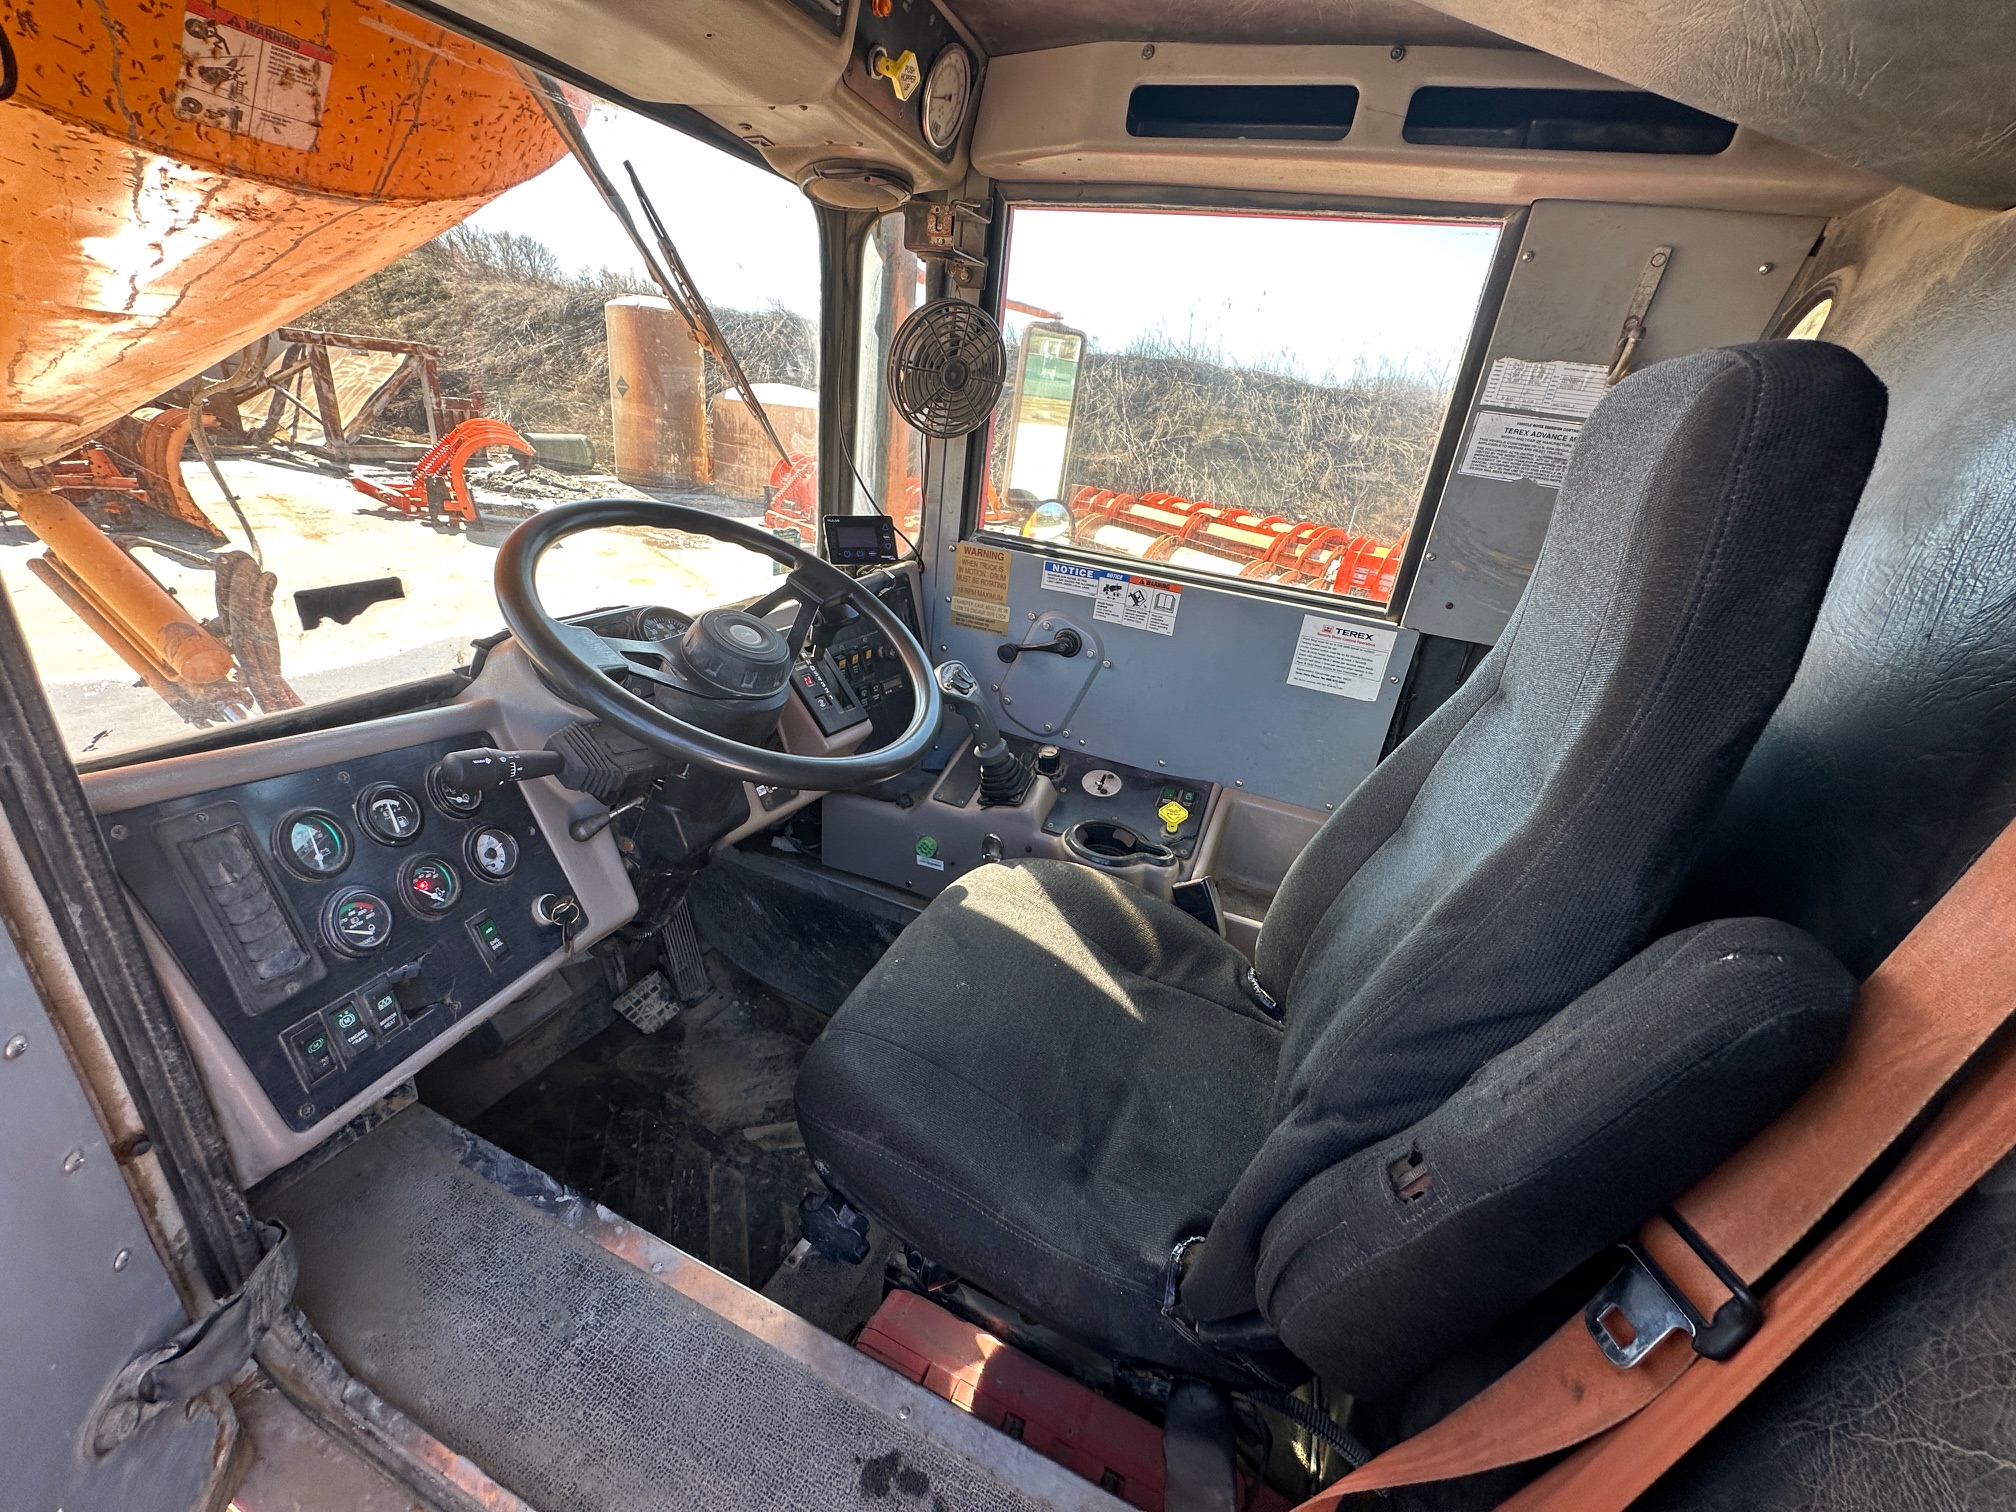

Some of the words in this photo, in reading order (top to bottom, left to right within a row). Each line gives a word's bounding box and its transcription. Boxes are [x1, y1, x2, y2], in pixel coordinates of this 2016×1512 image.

[244, 20, 300, 50] WARNING
[905, 65, 915, 74] PUSH
[901, 73, 916, 83] HOPPER
[1504, 427, 1529, 436] TEREX
[1530, 430, 1568, 441] ADVANCE
[964, 546, 1004, 561] WARNING
[979, 562, 997, 571] TRUCK
[1052, 564, 1094, 578] NOTICE
[956, 574, 970, 582] MUST
[981, 579, 1006, 590] ROTATING
[1146, 581, 1170, 590] WARNING
[978, 590, 1004, 600] MAXIMUM
[1336, 627, 1374, 641] TEREX
[347, 1028, 366, 1043] ENGINE
